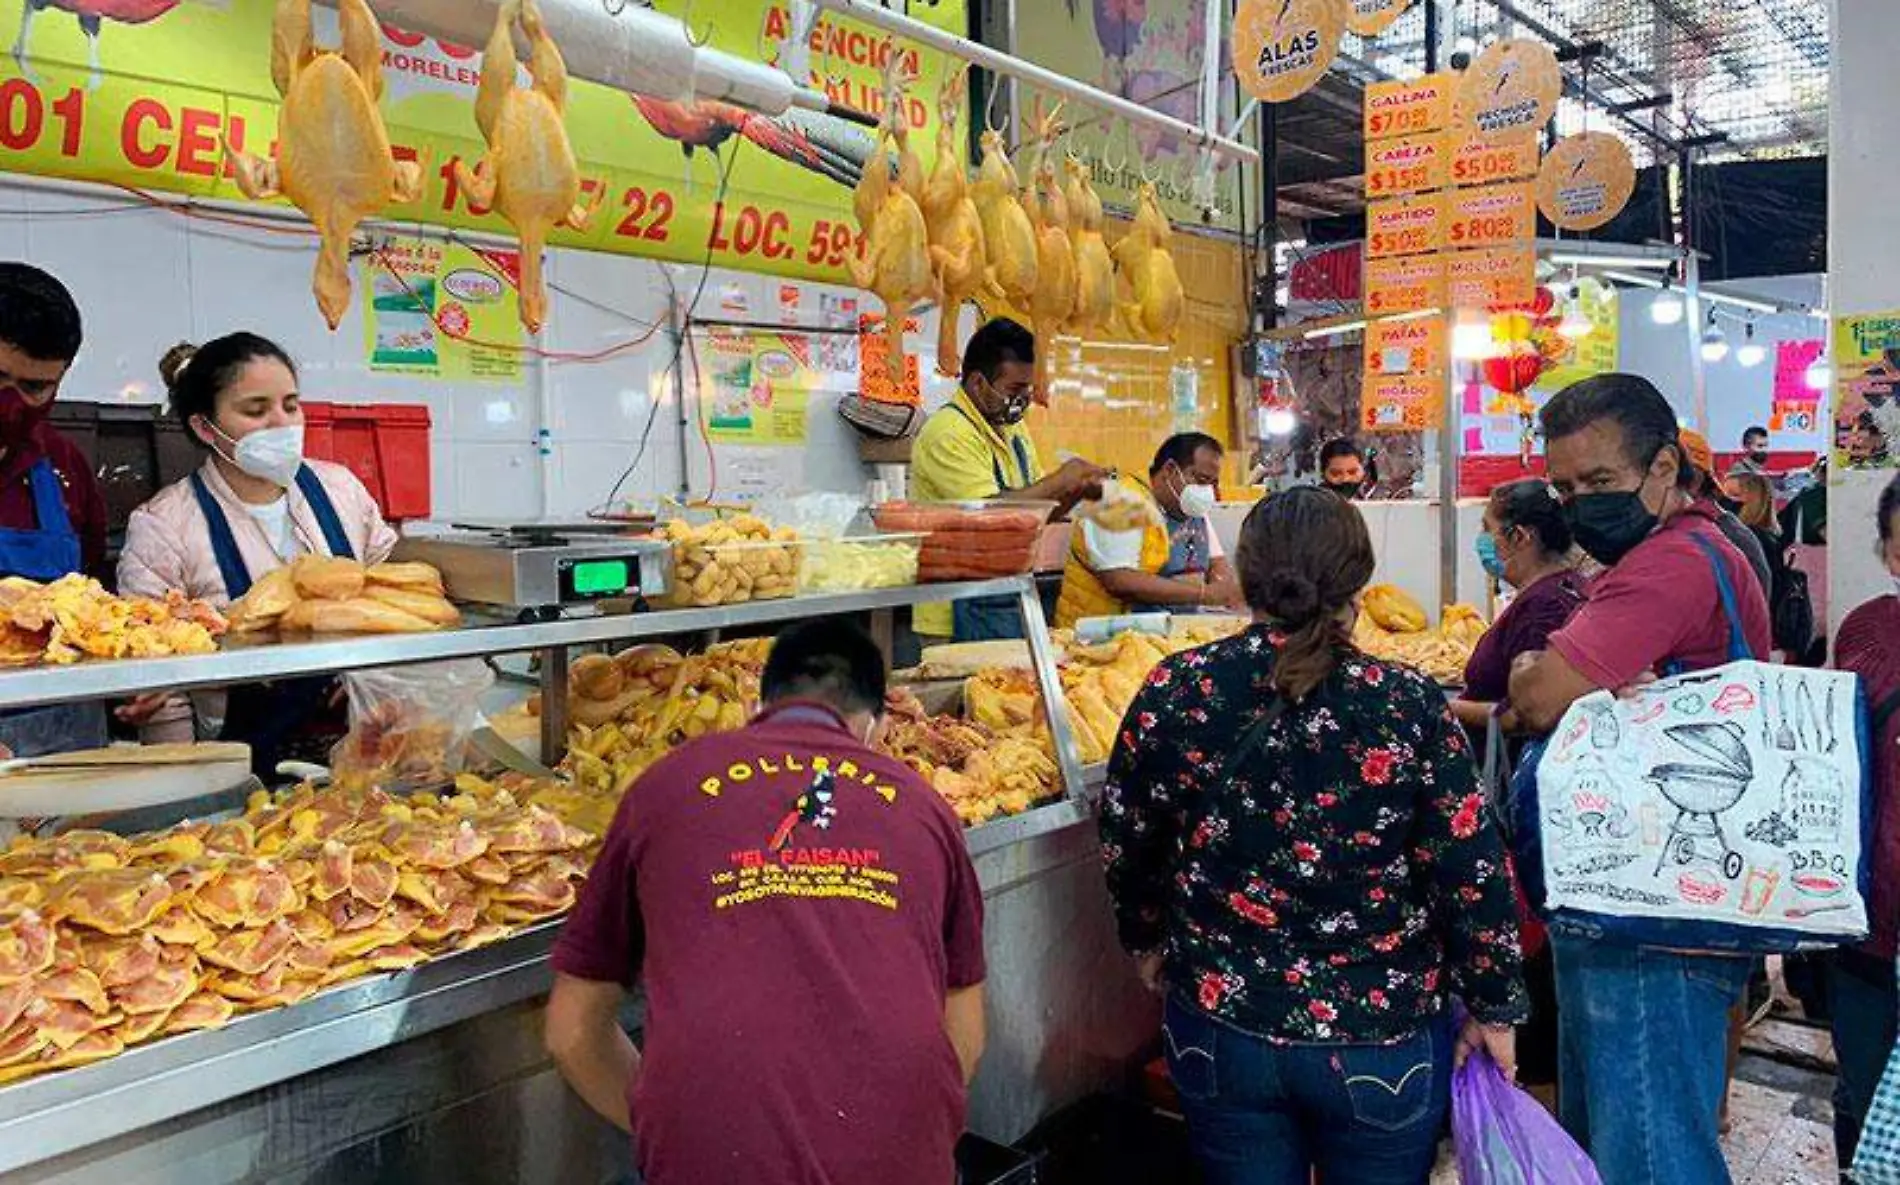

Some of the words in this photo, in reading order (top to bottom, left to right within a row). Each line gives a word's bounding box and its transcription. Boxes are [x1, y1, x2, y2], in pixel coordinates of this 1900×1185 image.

[765, 6, 917, 76] AENCIÓN
[1258, 30, 1319, 67] ALAS
[1370, 90, 1437, 108] GALLINA
[1373, 145, 1435, 162] CABEZA
[615, 186, 673, 242] 22
[708, 202, 795, 259] LOC.
[1380, 327, 1428, 342] PATAS
[701, 754, 897, 804] POLLERIA
